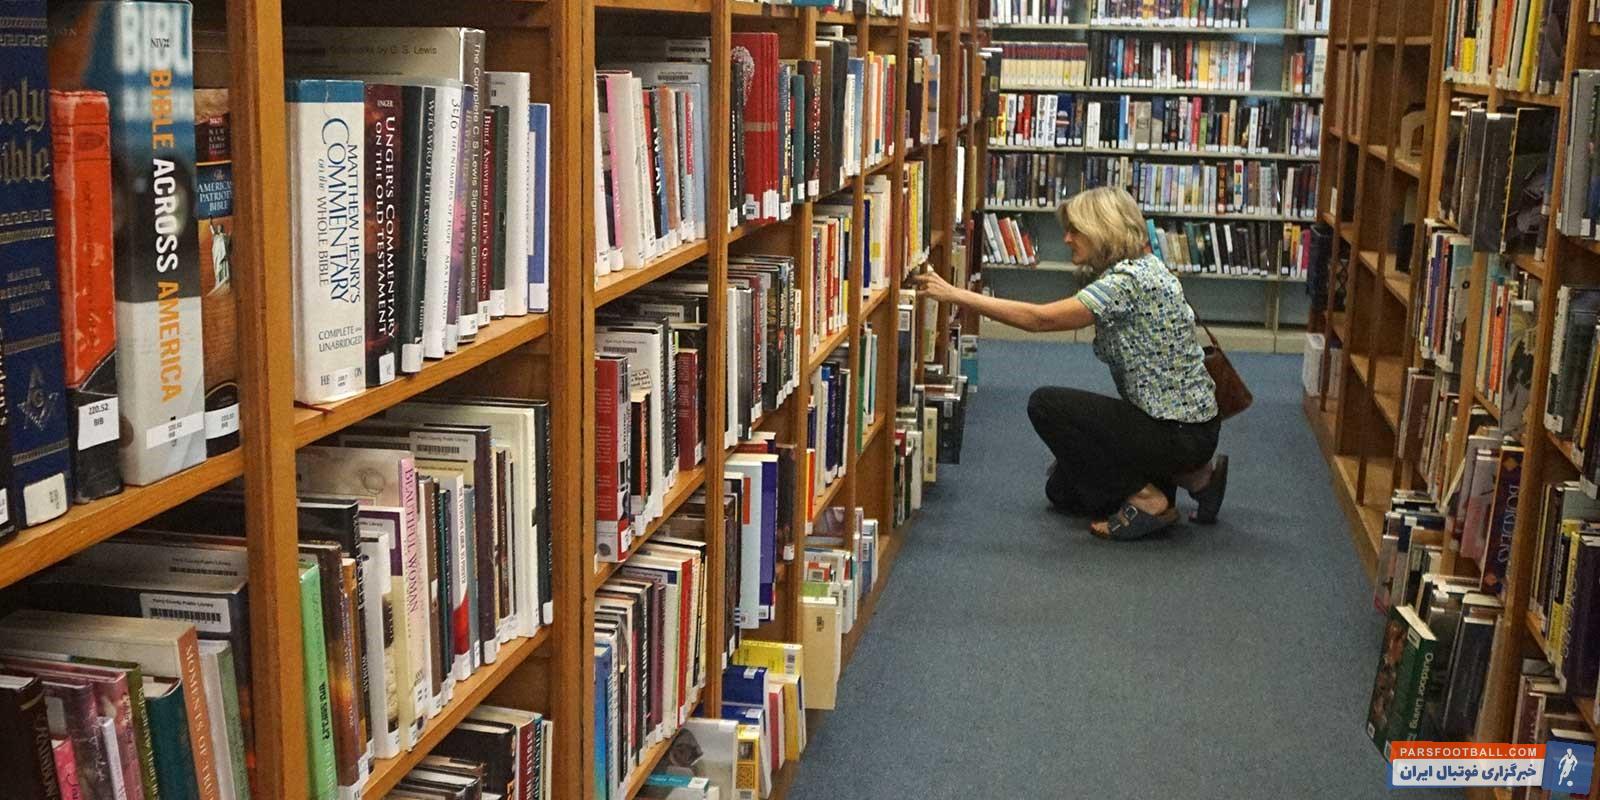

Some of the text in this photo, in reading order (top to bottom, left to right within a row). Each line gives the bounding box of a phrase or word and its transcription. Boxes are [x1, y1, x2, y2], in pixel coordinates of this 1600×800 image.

[473, 42, 481, 66] The
[0, 77, 47, 133] oly
[427, 99, 435, 132] WHO
[472, 68, 481, 122] Complete
[483, 115, 492, 146] BIBLE
[0, 137, 51, 184] ible
[425, 134, 433, 179] WROTE
[472, 153, 480, 187] Lewis
[483, 147, 491, 197] ANSWERS
[197, 182, 233, 193] AMERICA
[209, 201, 229, 212] BIBLE
[321, 117, 350, 303] COMMENTARY
[150, 69, 183, 405] BIBLE ACROSS AMERICA
[317, 196, 328, 246] WHOLE
[347, 144, 361, 304] MATTHEW HENRY'S
[375, 121, 387, 334] ON THE OLD TESTAMENT
[385, 116, 396, 338] UNGER'S COMMENTARY
[470, 189, 479, 242] Signature
[481, 211, 490, 245] LIFE'S
[318, 250, 329, 288] BIBLE
[470, 246, 478, 294] Classics
[319, 326, 354, 341] COMPLETE
[319, 336, 363, 353] UNABRIDGED
[404, 468, 418, 613] BEAUTIFUL WOMAN
[1418, 652, 1434, 697] Outdoor
[185, 645, 209, 734] MOMENTS
[199, 735, 209, 760] OF
